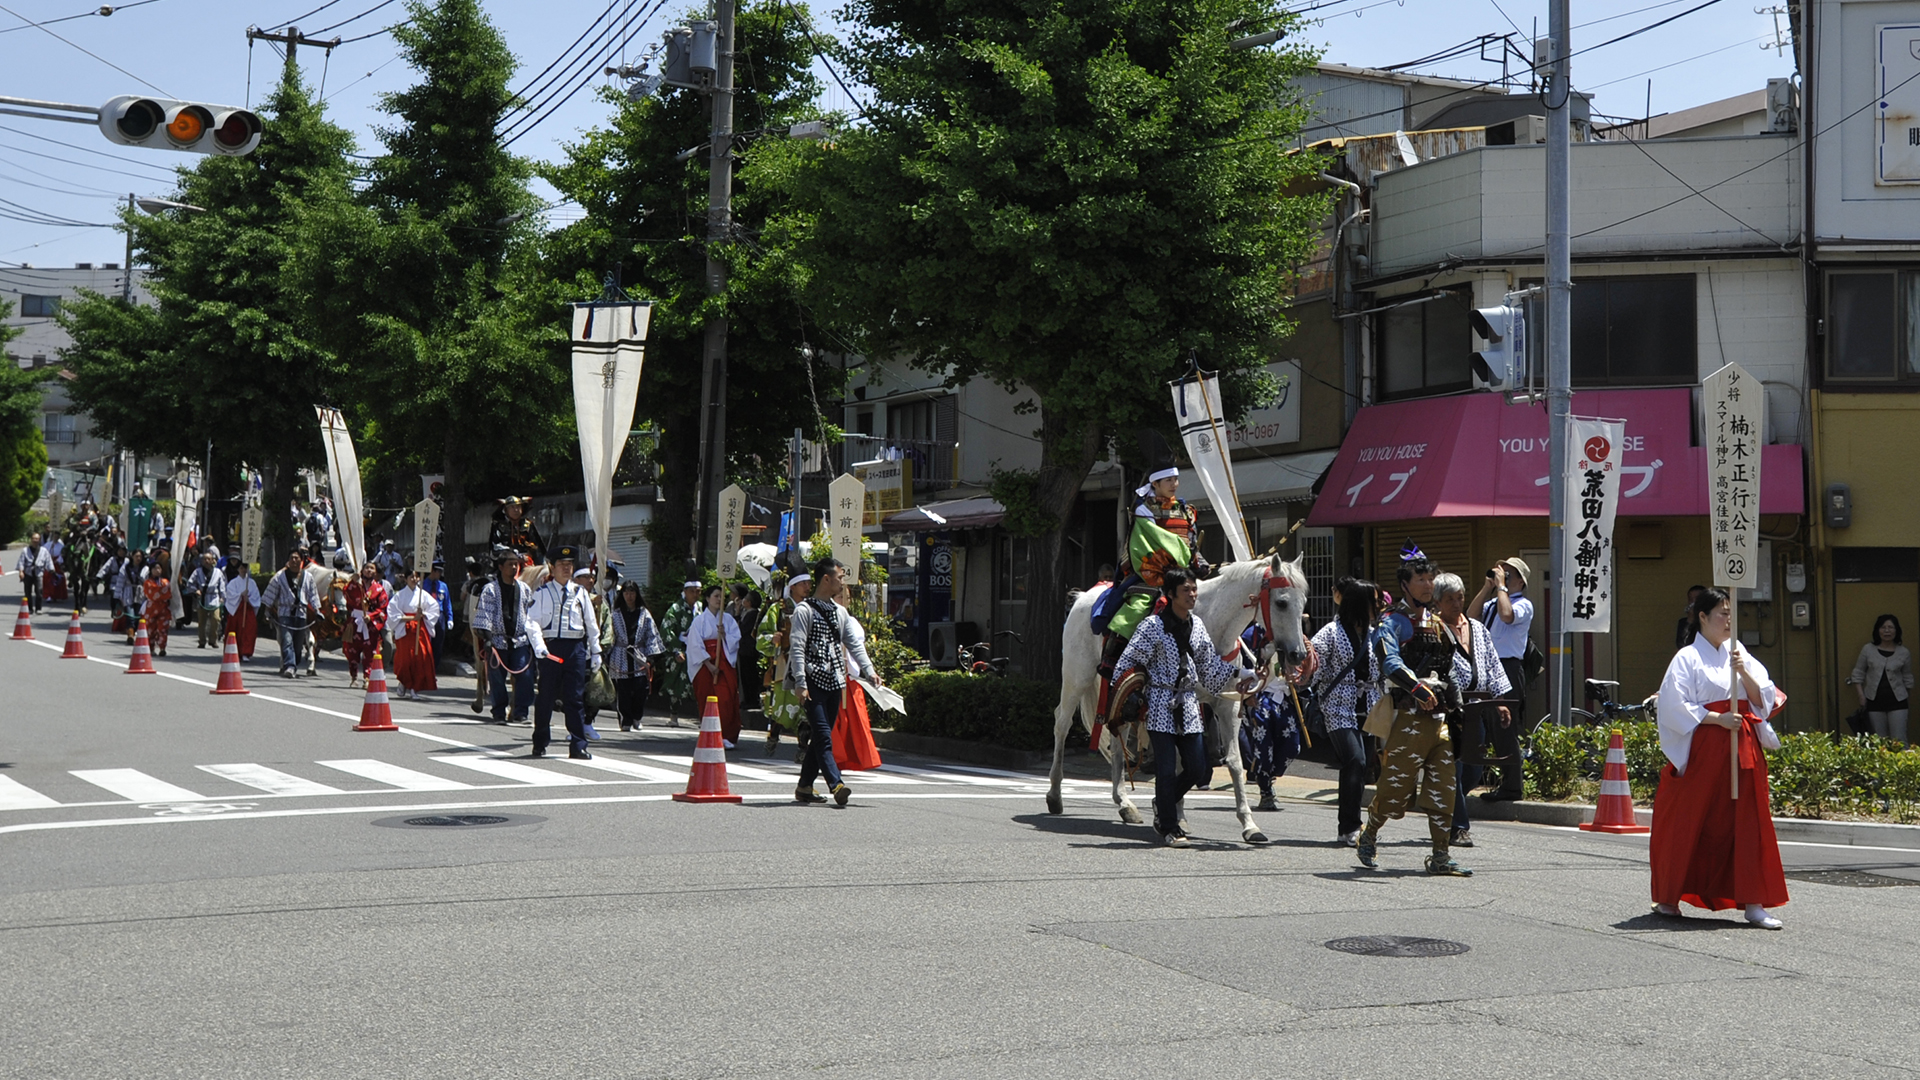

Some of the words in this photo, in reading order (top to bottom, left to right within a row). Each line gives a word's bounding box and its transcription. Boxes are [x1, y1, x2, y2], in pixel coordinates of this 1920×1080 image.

[1727, 370, 1741, 402] 少将
[1234, 423, 1280, 442] 511-0967
[1715, 400, 1729, 469] スマイル神戸
[1357, 447, 1378, 463] YOU
[1375, 446, 1395, 461] YOU
[1393, 443, 1428, 460] HOUSE
[1499, 438, 1533, 452] YOU
[1346, 465, 1417, 508] イブ
[133, 504, 147, 517] 六
[839, 497, 853, 548] 将前兵
[932, 545, 953, 555] COFFE
[1715, 539, 1729, 554] 様
[722, 564, 731, 573] 25
[1728, 559, 1744, 574] 23
